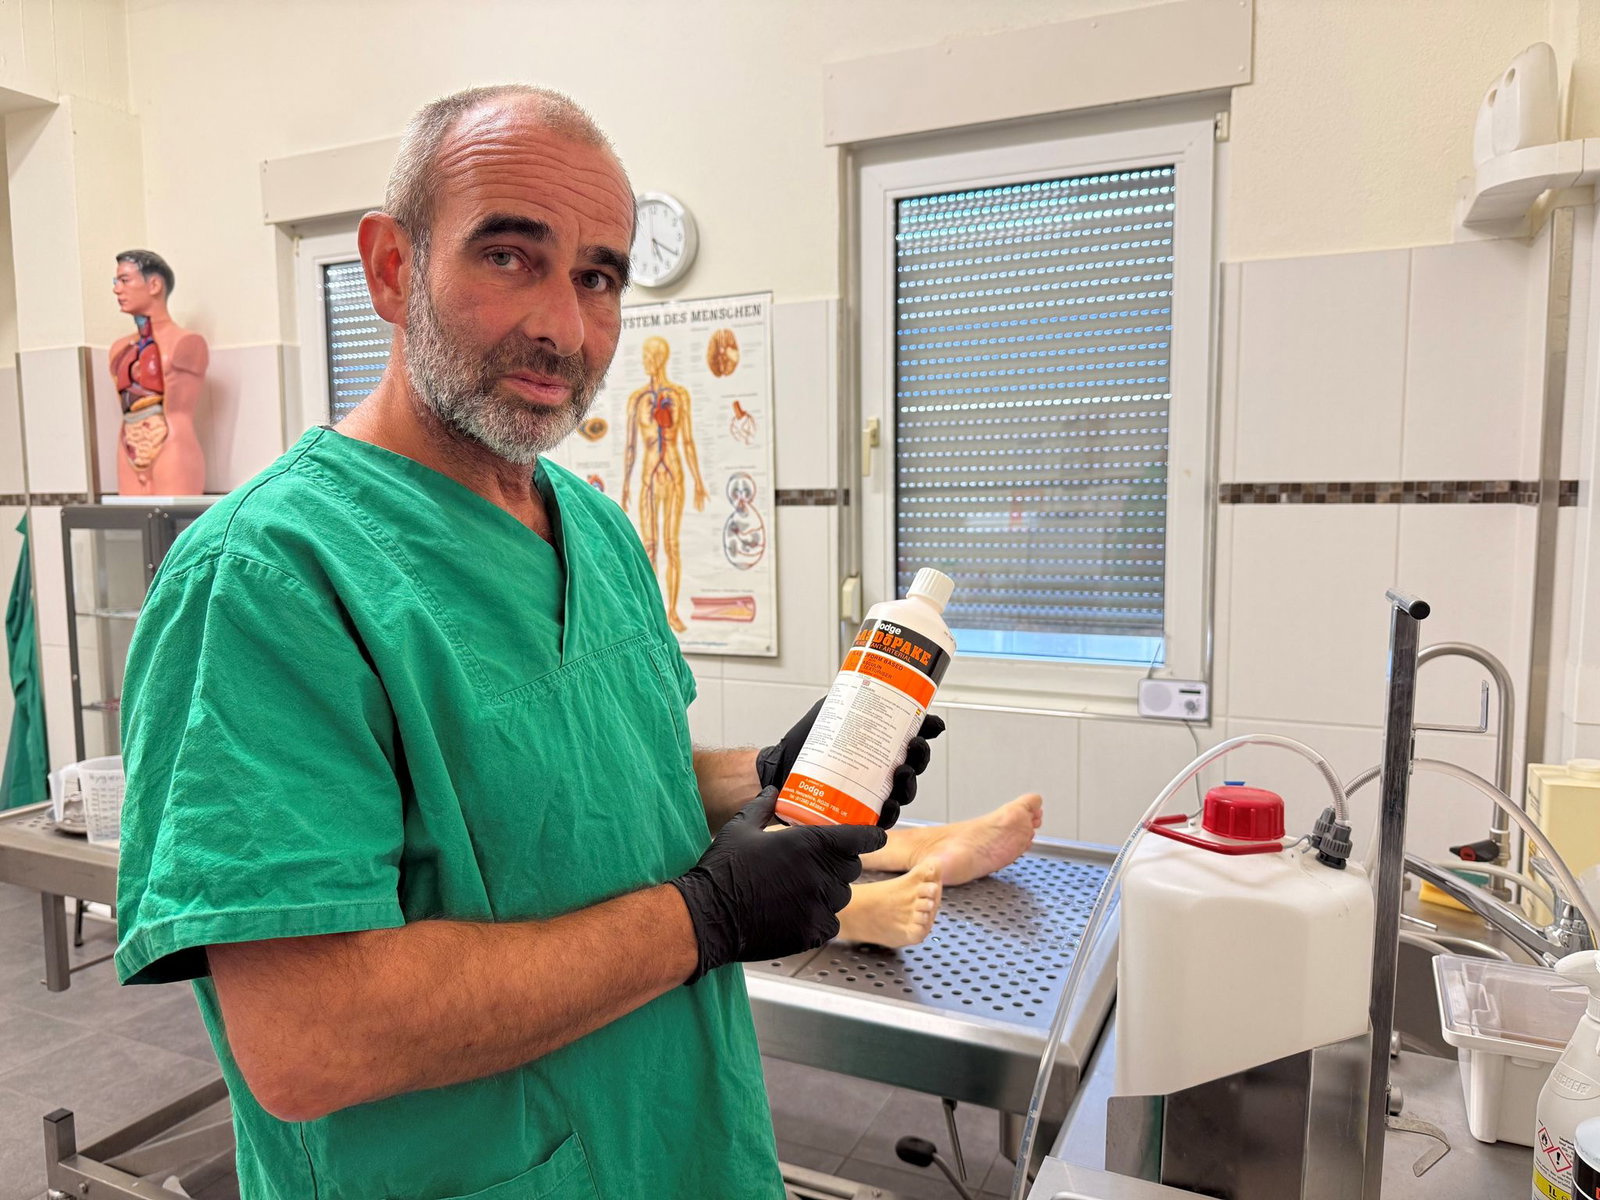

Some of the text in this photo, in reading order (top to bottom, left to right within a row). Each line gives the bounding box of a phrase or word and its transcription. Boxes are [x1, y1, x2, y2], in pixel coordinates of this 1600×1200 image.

[622, 303, 762, 330] YSTEM DES MENSCHEN
[798, 780, 825, 797] Dodge
